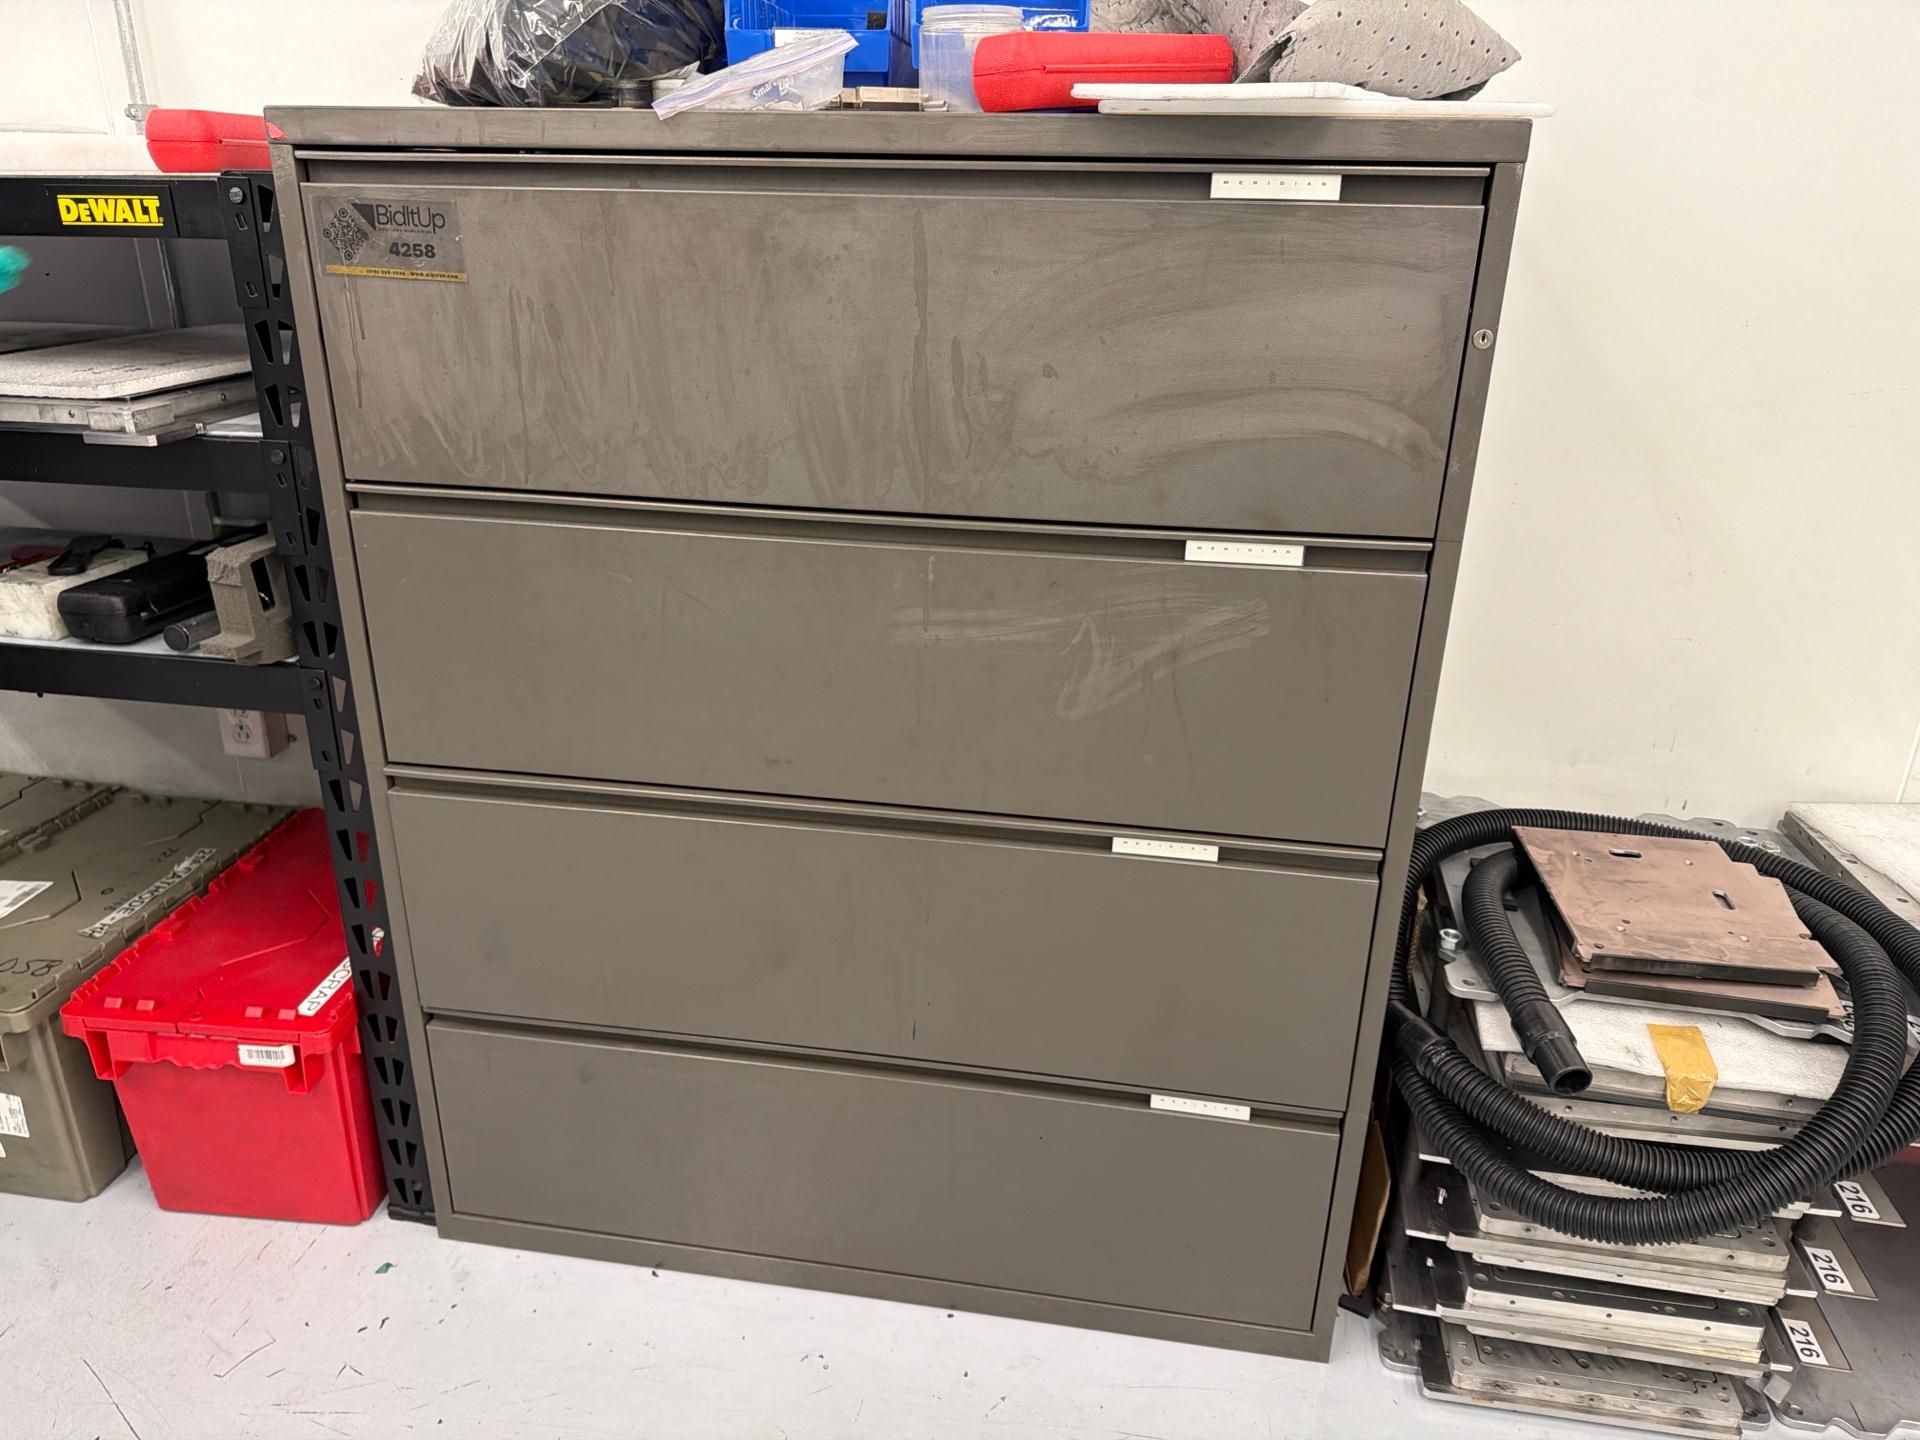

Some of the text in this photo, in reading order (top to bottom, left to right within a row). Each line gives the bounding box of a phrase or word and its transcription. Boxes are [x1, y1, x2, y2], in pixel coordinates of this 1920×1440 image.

[375, 204, 446, 234] BidItUp
[389, 242, 436, 259] 4258
[1838, 1183, 1873, 1215] 216
[1812, 1252, 1844, 1285] 216
[1789, 1325, 1821, 1359] 216
